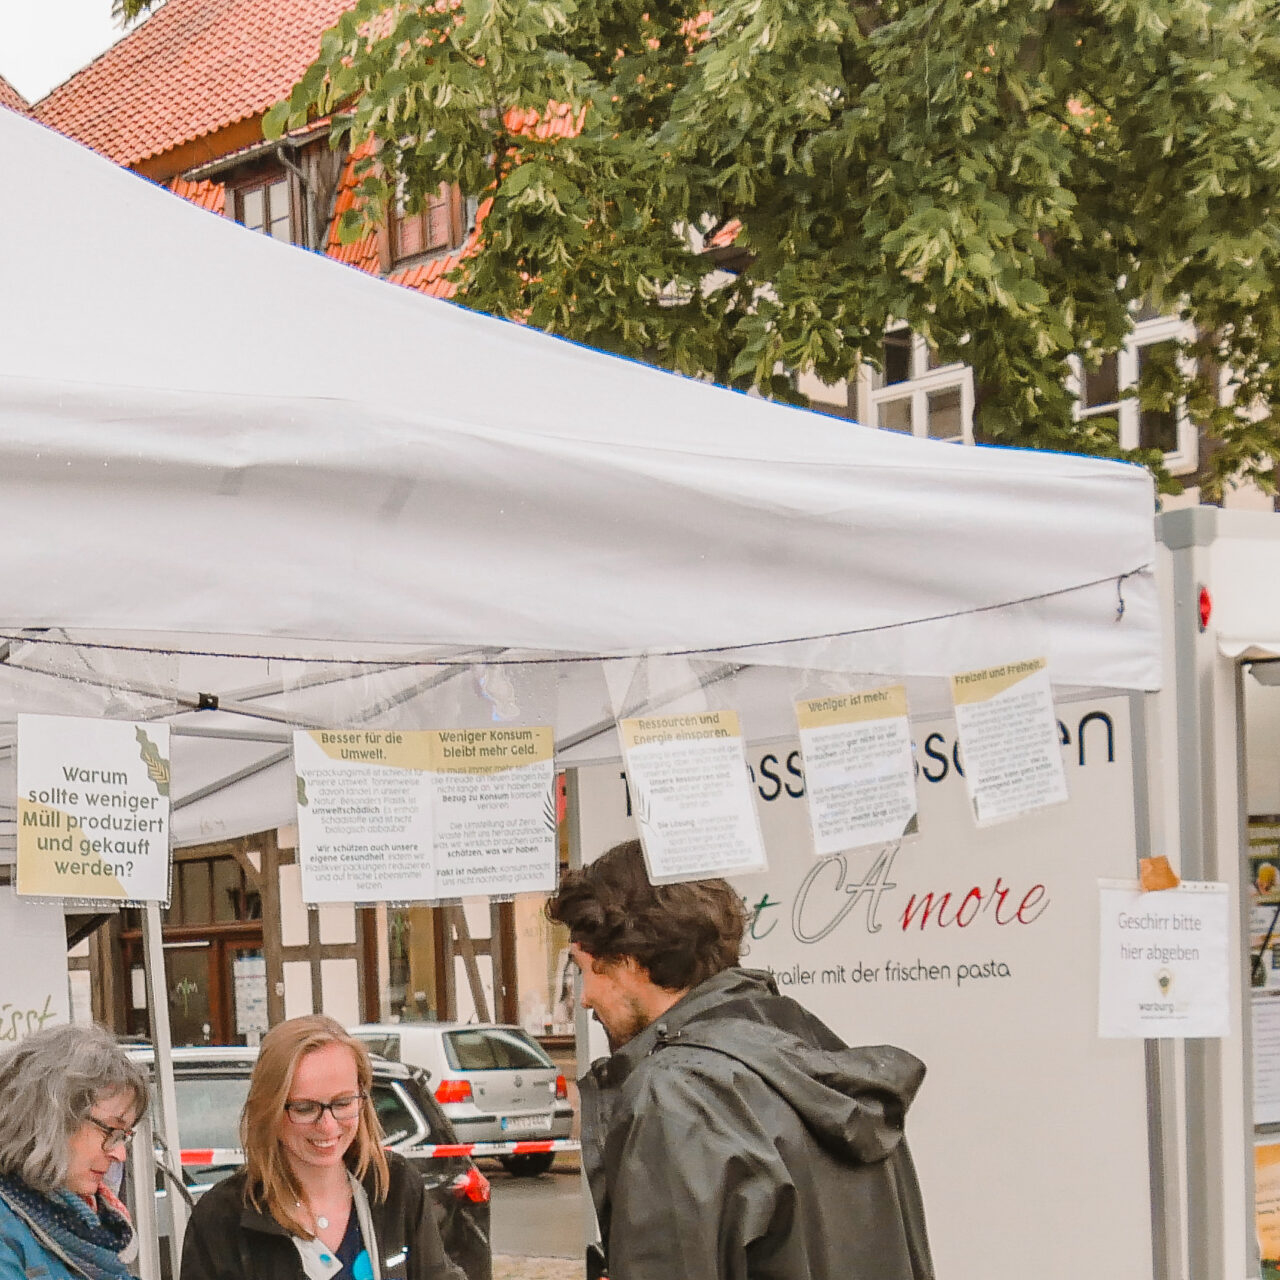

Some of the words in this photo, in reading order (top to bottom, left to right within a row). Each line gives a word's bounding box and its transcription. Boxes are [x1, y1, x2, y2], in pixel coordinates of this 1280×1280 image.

[989, 667, 1006, 679] und
[808, 699, 848, 713] Weniger
[850, 695, 861, 707] ist
[639, 717, 698, 730] Ressourcen
[701, 713, 720, 725] und
[322, 733, 361, 743] Besser
[365, 732, 380, 743] für
[385, 733, 402, 743] die
[439, 730, 486, 743] Weniger
[490, 730, 532, 741] Konsum
[634, 733, 673, 746] Energie
[676, 729, 731, 743] einsparen.
[341, 749, 387, 760] Umwelt.
[444, 747, 476, 758] bleibt
[479, 745, 508, 757] mehr
[512, 744, 538, 755] Geld.
[62, 766, 128, 786] Warum
[28, 786, 78, 806] sollte
[86, 790, 159, 812] weniger
[23, 810, 62, 829] Müll
[66, 812, 163, 836] produziert
[38, 834, 74, 854] und
[80, 835, 150, 859] gekauft
[333, 844, 369, 852] schützen
[371, 844, 390, 852] auch
[392, 844, 418, 852] unsere
[56, 858, 134, 878] werden?
[1118, 912, 1169, 930] Geschirr
[1173, 914, 1202, 931] bitte
[1121, 943, 1143, 960] hier
[1147, 945, 1200, 963] abgeben
[821, 962, 848, 983] mit
[852, 962, 880, 983] der
[885, 960, 951, 982] frischen
[956, 962, 1012, 988] pasta
